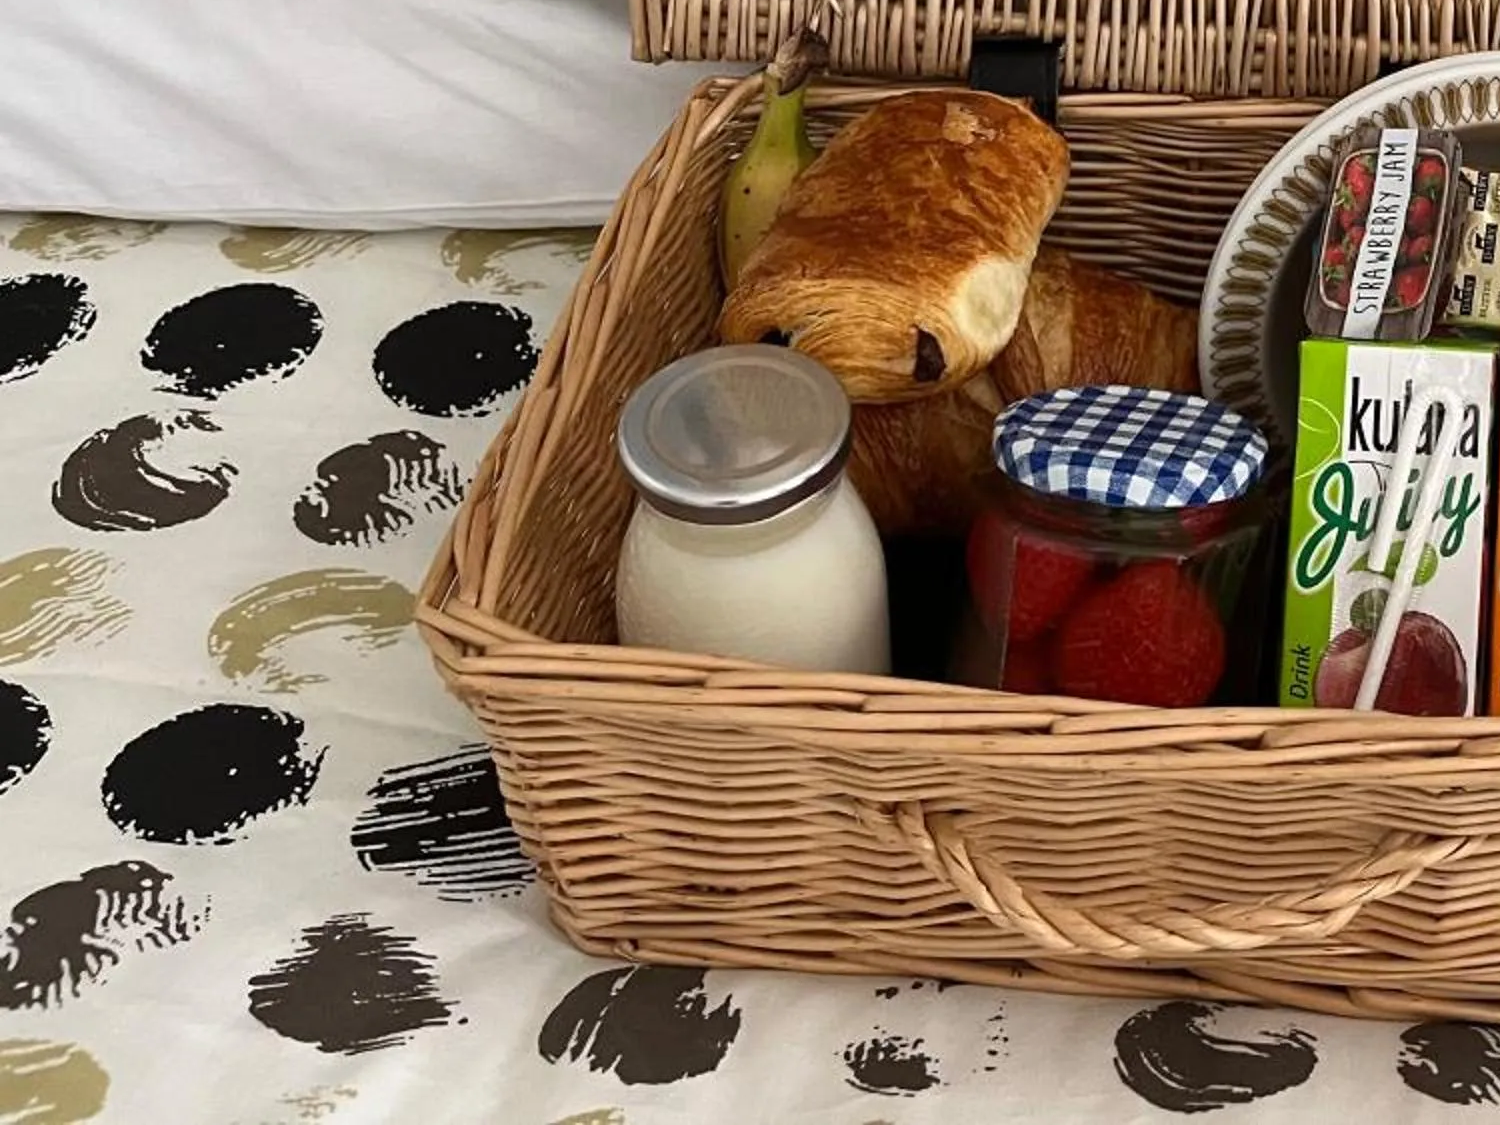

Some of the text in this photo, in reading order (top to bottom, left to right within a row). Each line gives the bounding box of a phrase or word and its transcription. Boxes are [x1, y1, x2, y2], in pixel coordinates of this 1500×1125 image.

[1354, 142, 1409, 314] STRAWBERRY JAM
[1295, 461, 1481, 589] Juiy
[1289, 643, 1312, 700] Drink
